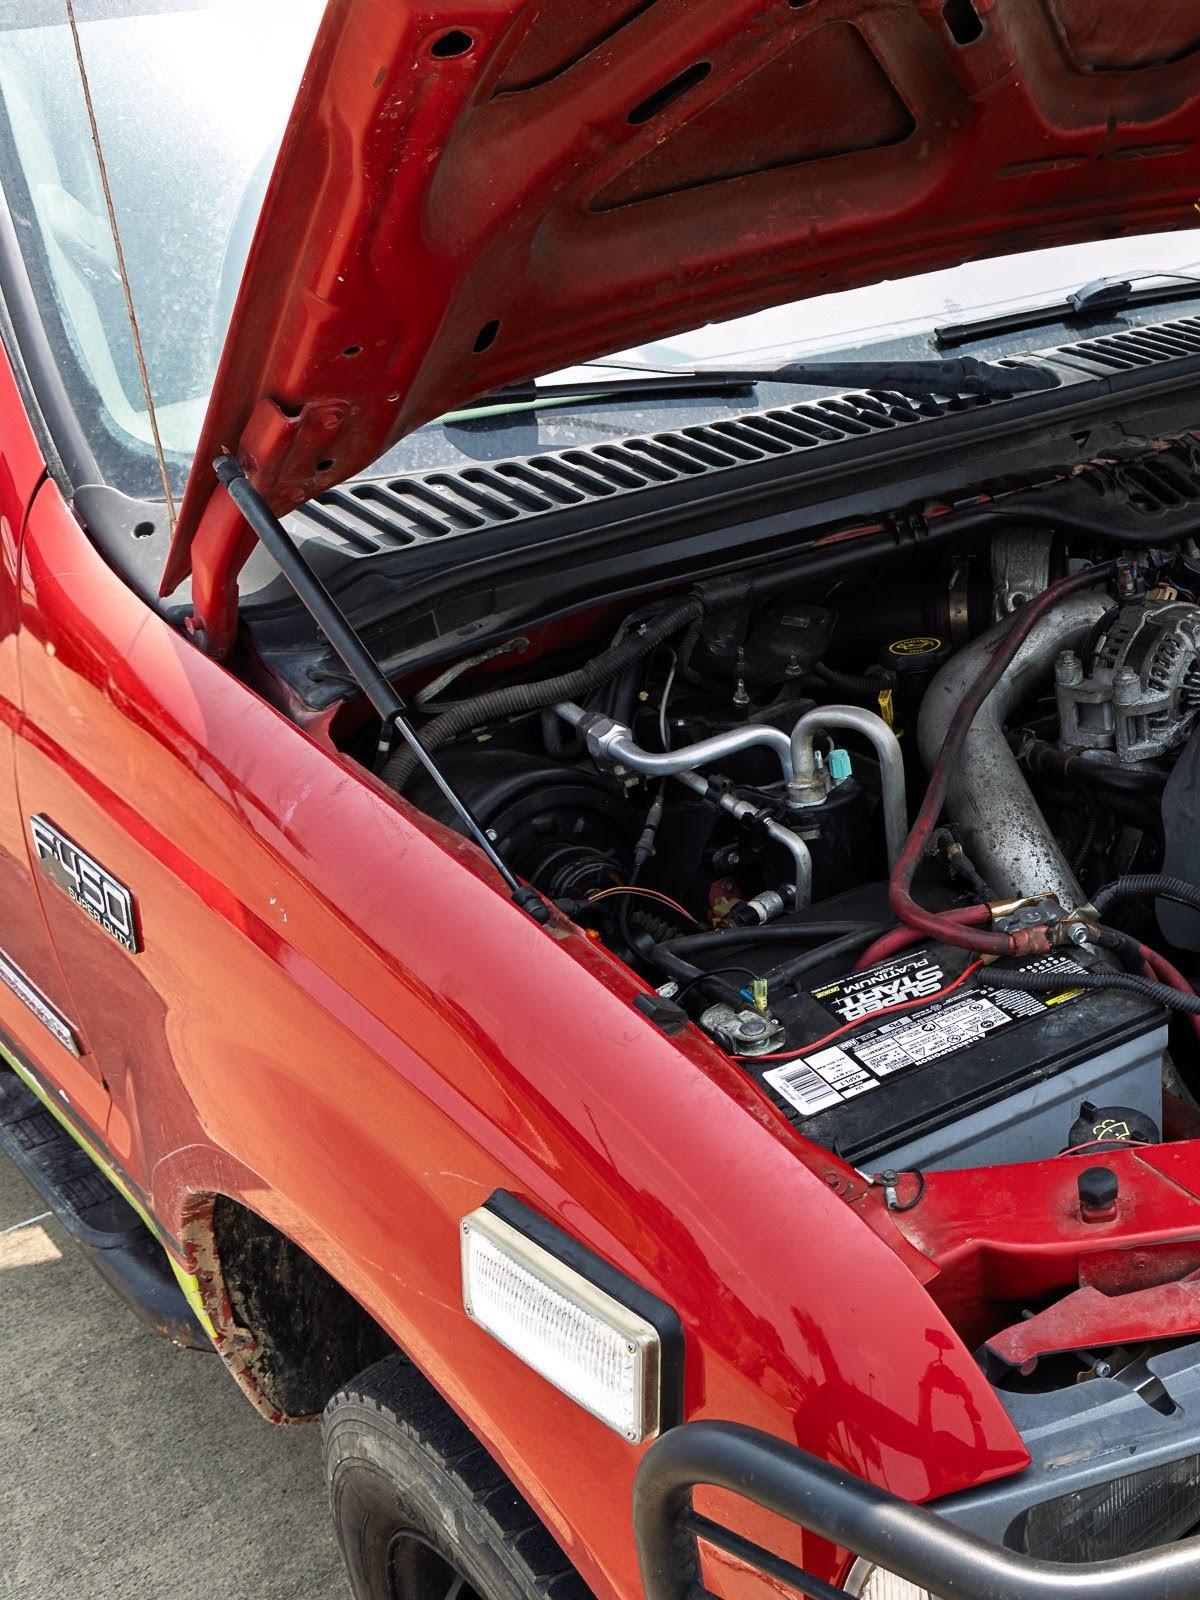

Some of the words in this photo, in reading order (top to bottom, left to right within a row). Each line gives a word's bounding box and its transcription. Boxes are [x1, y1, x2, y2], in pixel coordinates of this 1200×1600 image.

[68, 886, 101, 924] SUPER
[103, 921, 131, 950] DUTY
[835, 965, 944, 1014] START
[843, 958, 929, 994] PLATINUM
[842, 980, 942, 1022] SUPER
